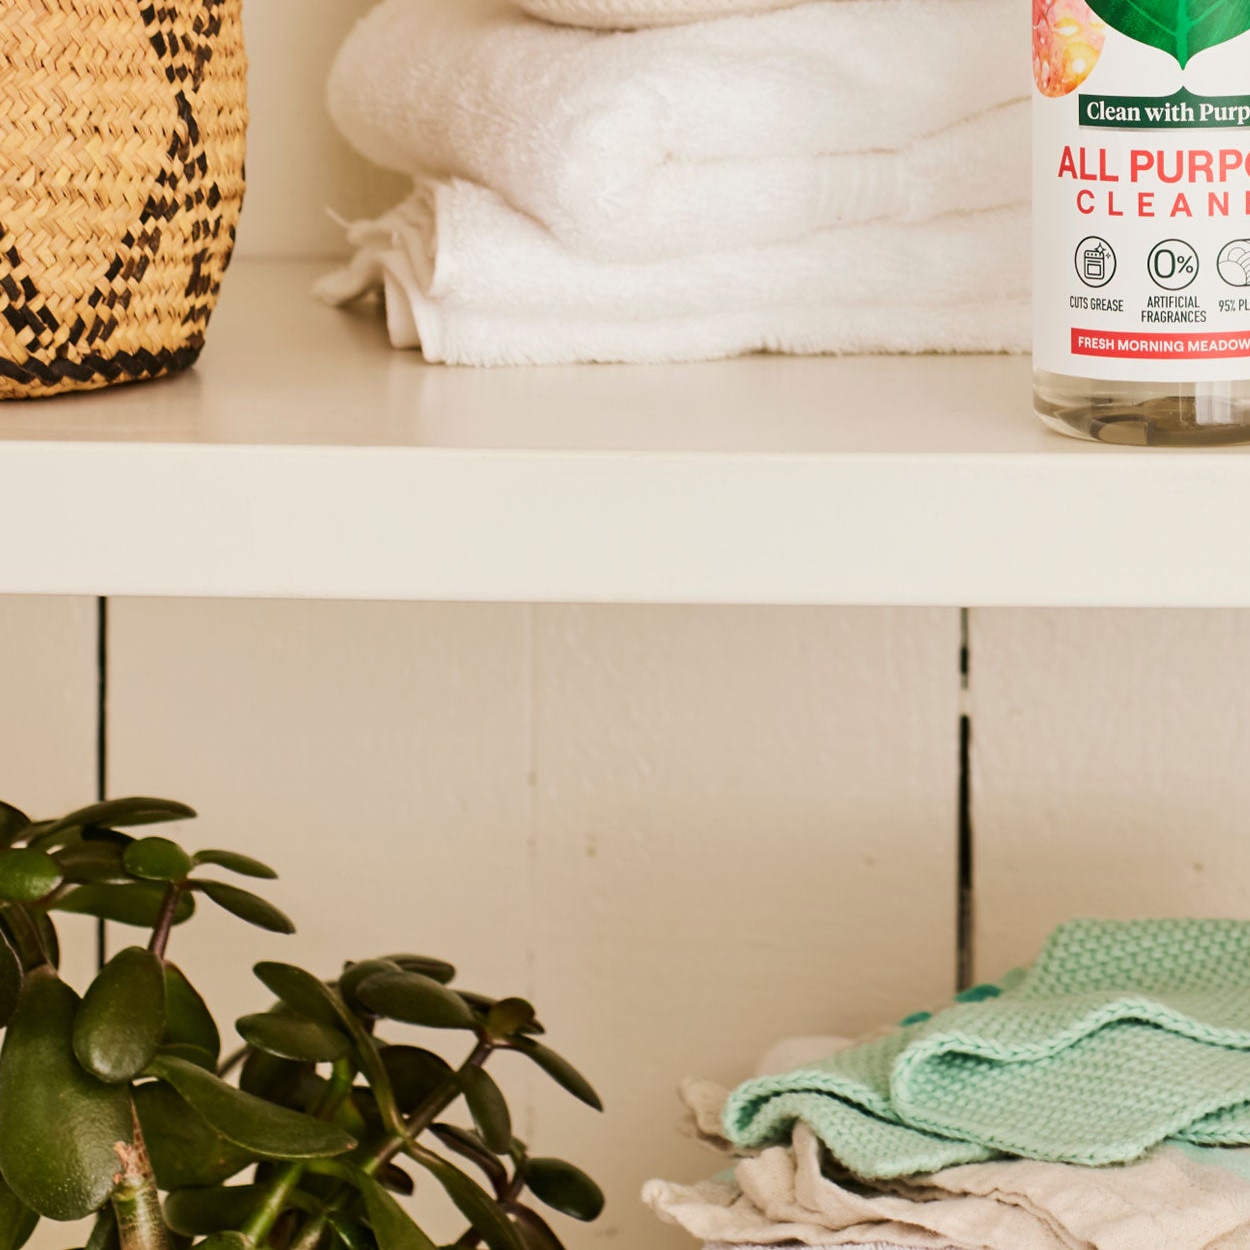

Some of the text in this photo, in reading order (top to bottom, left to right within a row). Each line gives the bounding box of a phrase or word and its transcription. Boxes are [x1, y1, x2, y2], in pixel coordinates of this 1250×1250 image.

[1086, 101, 1142, 122] Clean
[1147, 102, 1196, 122] with
[1057, 145, 1119, 182] ALL
[1154, 248, 1194, 280] 0%
[1069, 295, 1124, 312] CUTS GREASE
[1146, 295, 1200, 308] ARTIFICIAL
[1218, 299, 1236, 312] 95%
[1141, 310, 1207, 323] FRAGRANCES
[1078, 336, 1115, 351] FRESH
[1117, 339, 1185, 353] MORNING
